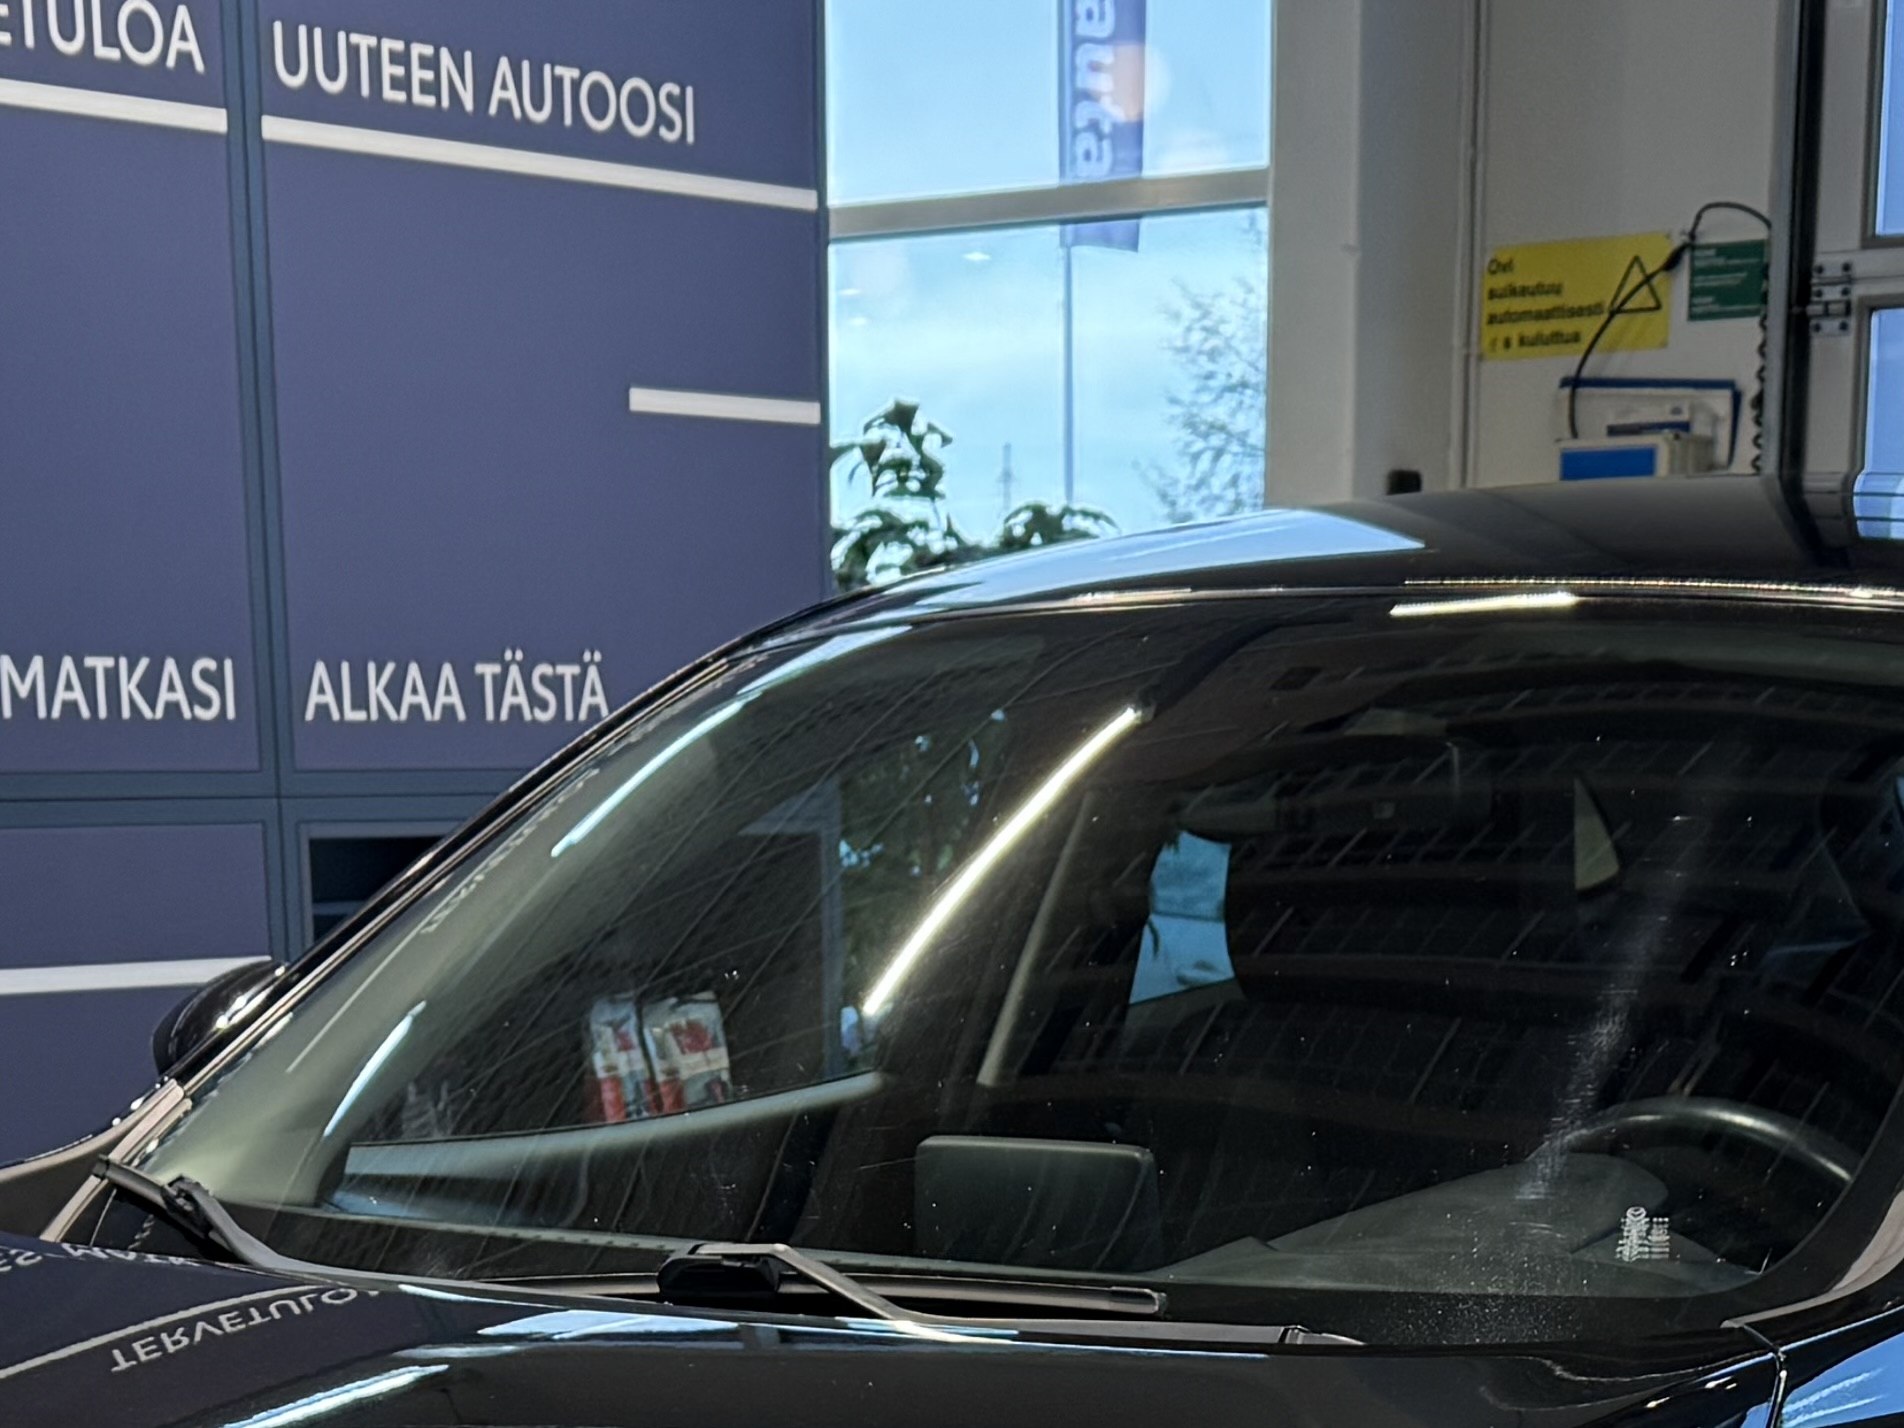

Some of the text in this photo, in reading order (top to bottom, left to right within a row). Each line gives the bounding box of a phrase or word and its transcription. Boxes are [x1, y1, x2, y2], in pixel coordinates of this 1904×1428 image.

[272, 19, 475, 114] UUTEEN
[487, 54, 696, 145] AUTOOSI
[304, 659, 466, 724] ALKAA
[473, 647, 610, 723] TÄSTÄ
